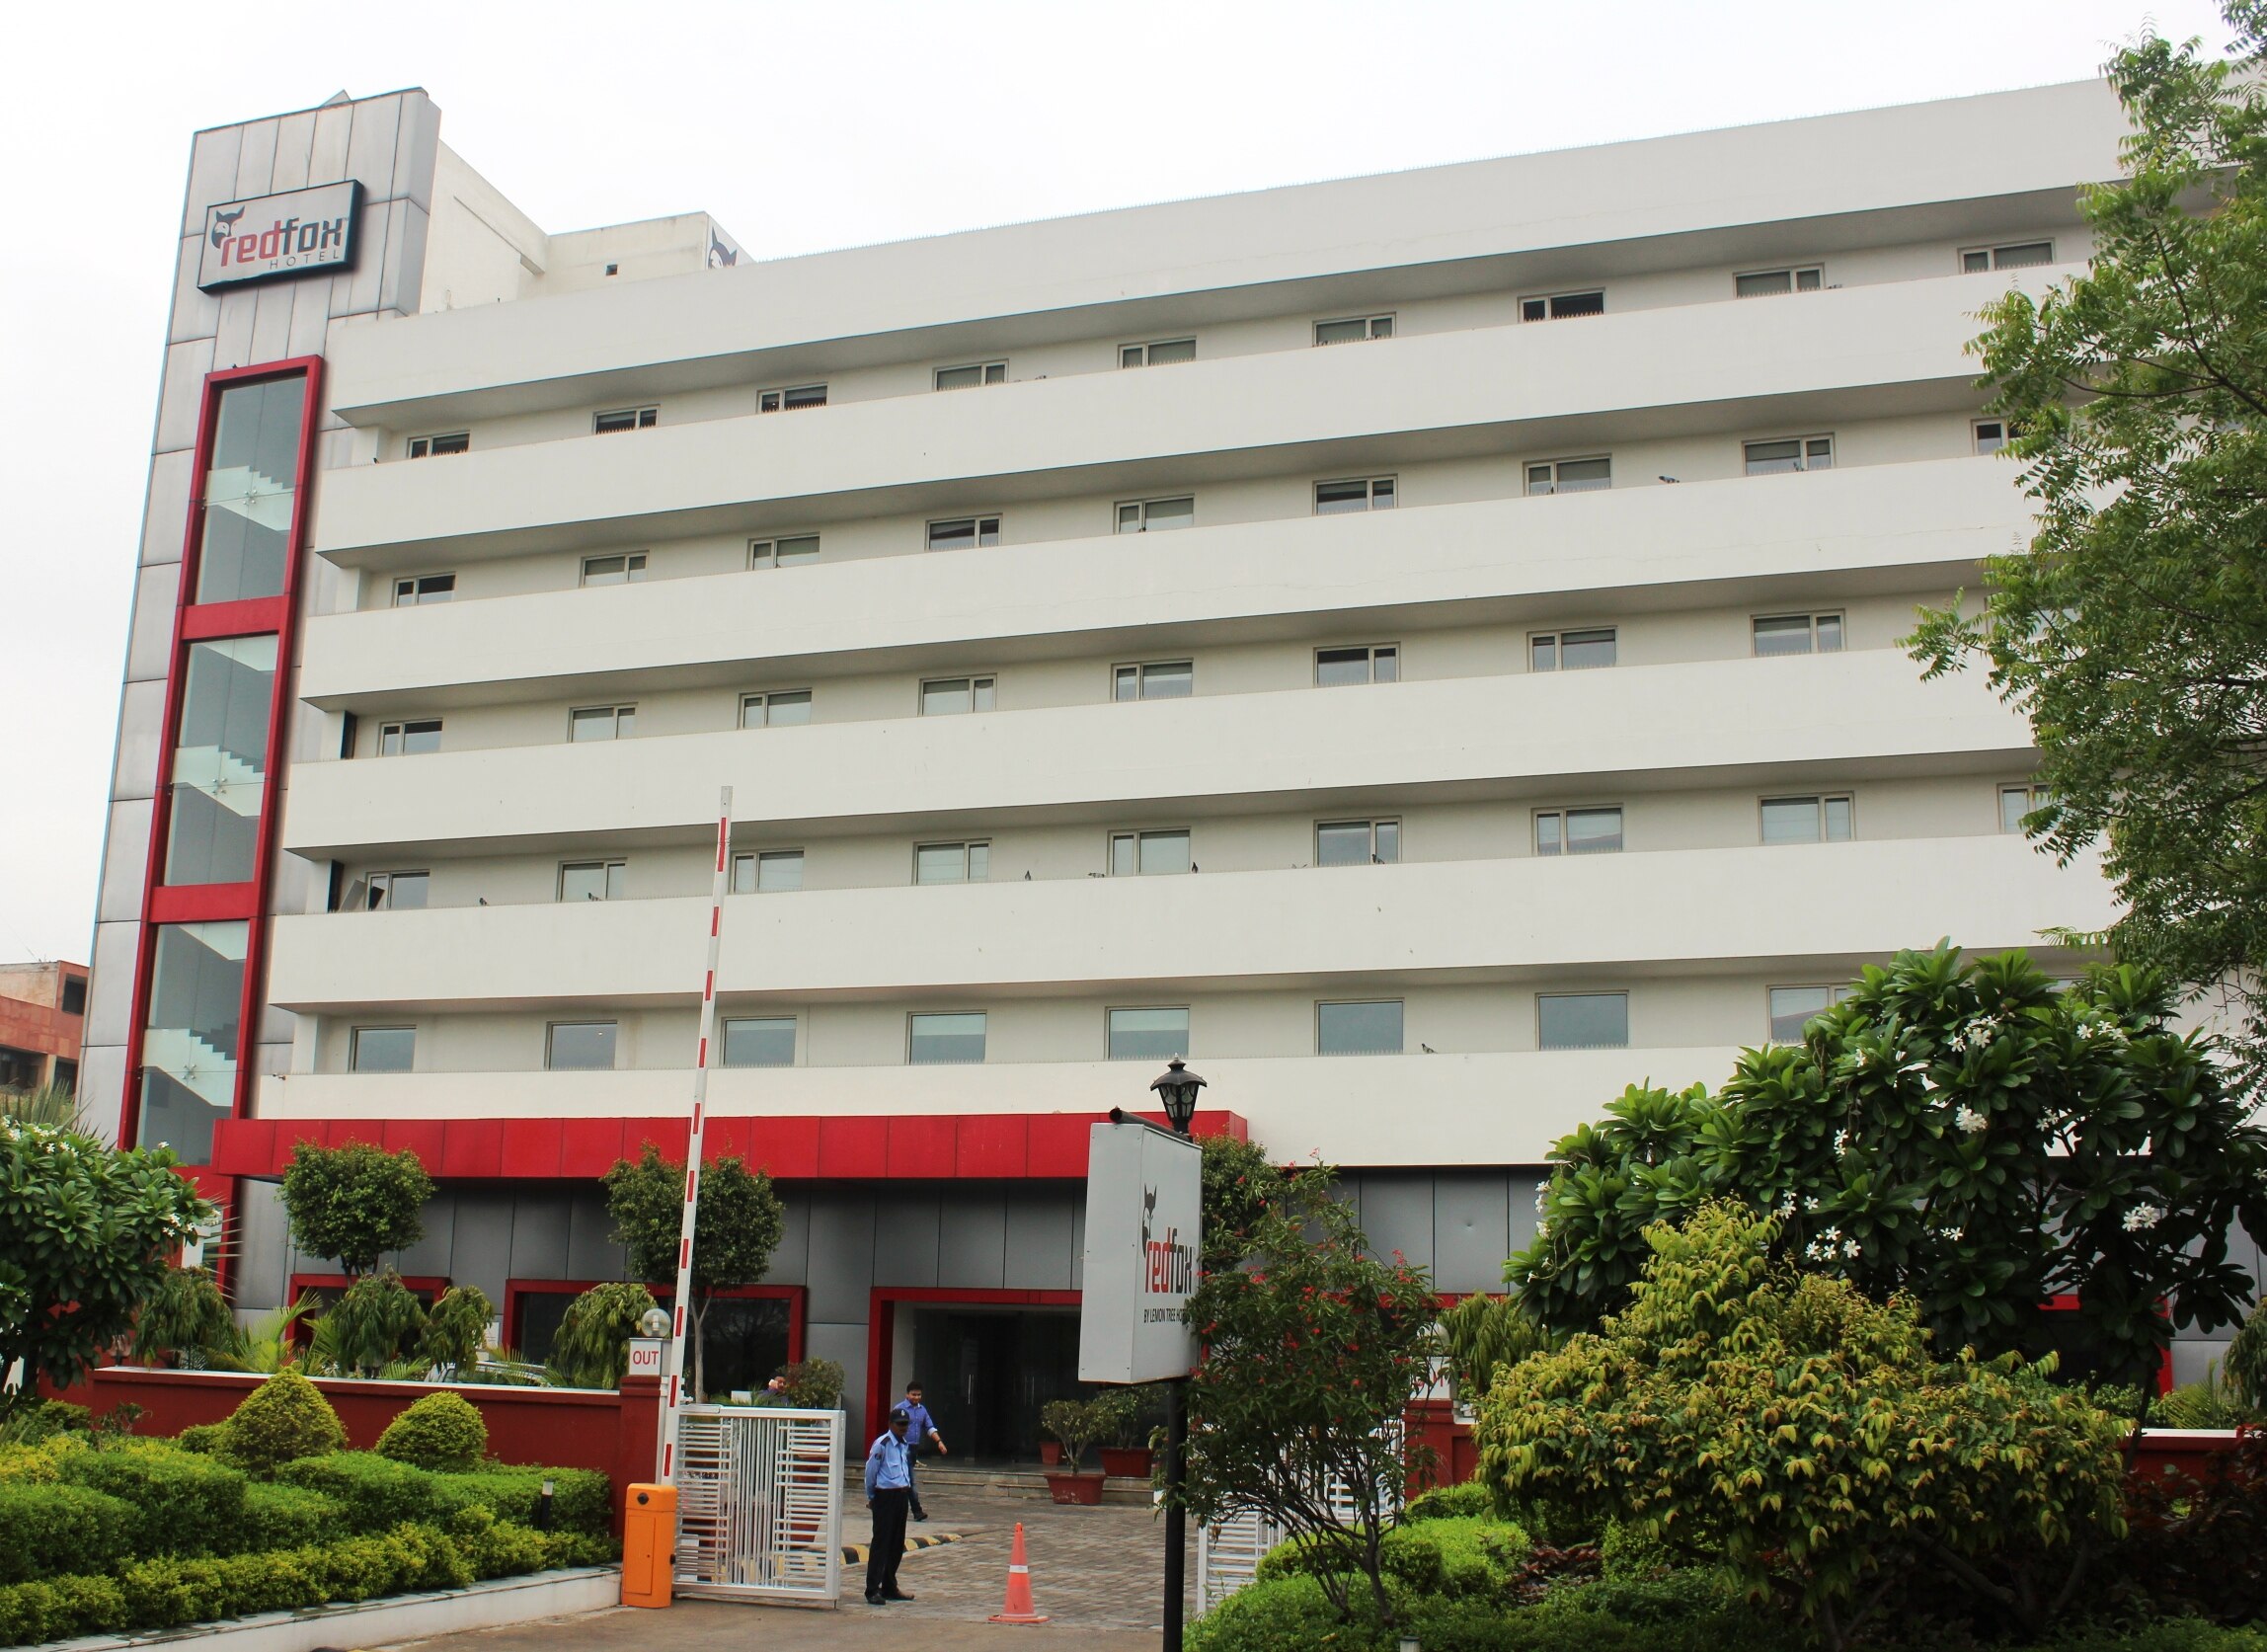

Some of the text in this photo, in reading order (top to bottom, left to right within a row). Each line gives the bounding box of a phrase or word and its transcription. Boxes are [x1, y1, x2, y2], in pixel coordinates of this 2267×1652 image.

[220, 217, 343, 268] redfox
[270, 251, 339, 270] HOTEL
[1145, 1226, 1192, 1294] redfox
[1143, 1308, 1149, 1323] BY
[1150, 1308, 1165, 1322] LEMON
[1166, 1307, 1176, 1322] TREE
[632, 1350, 660, 1366] OUT
